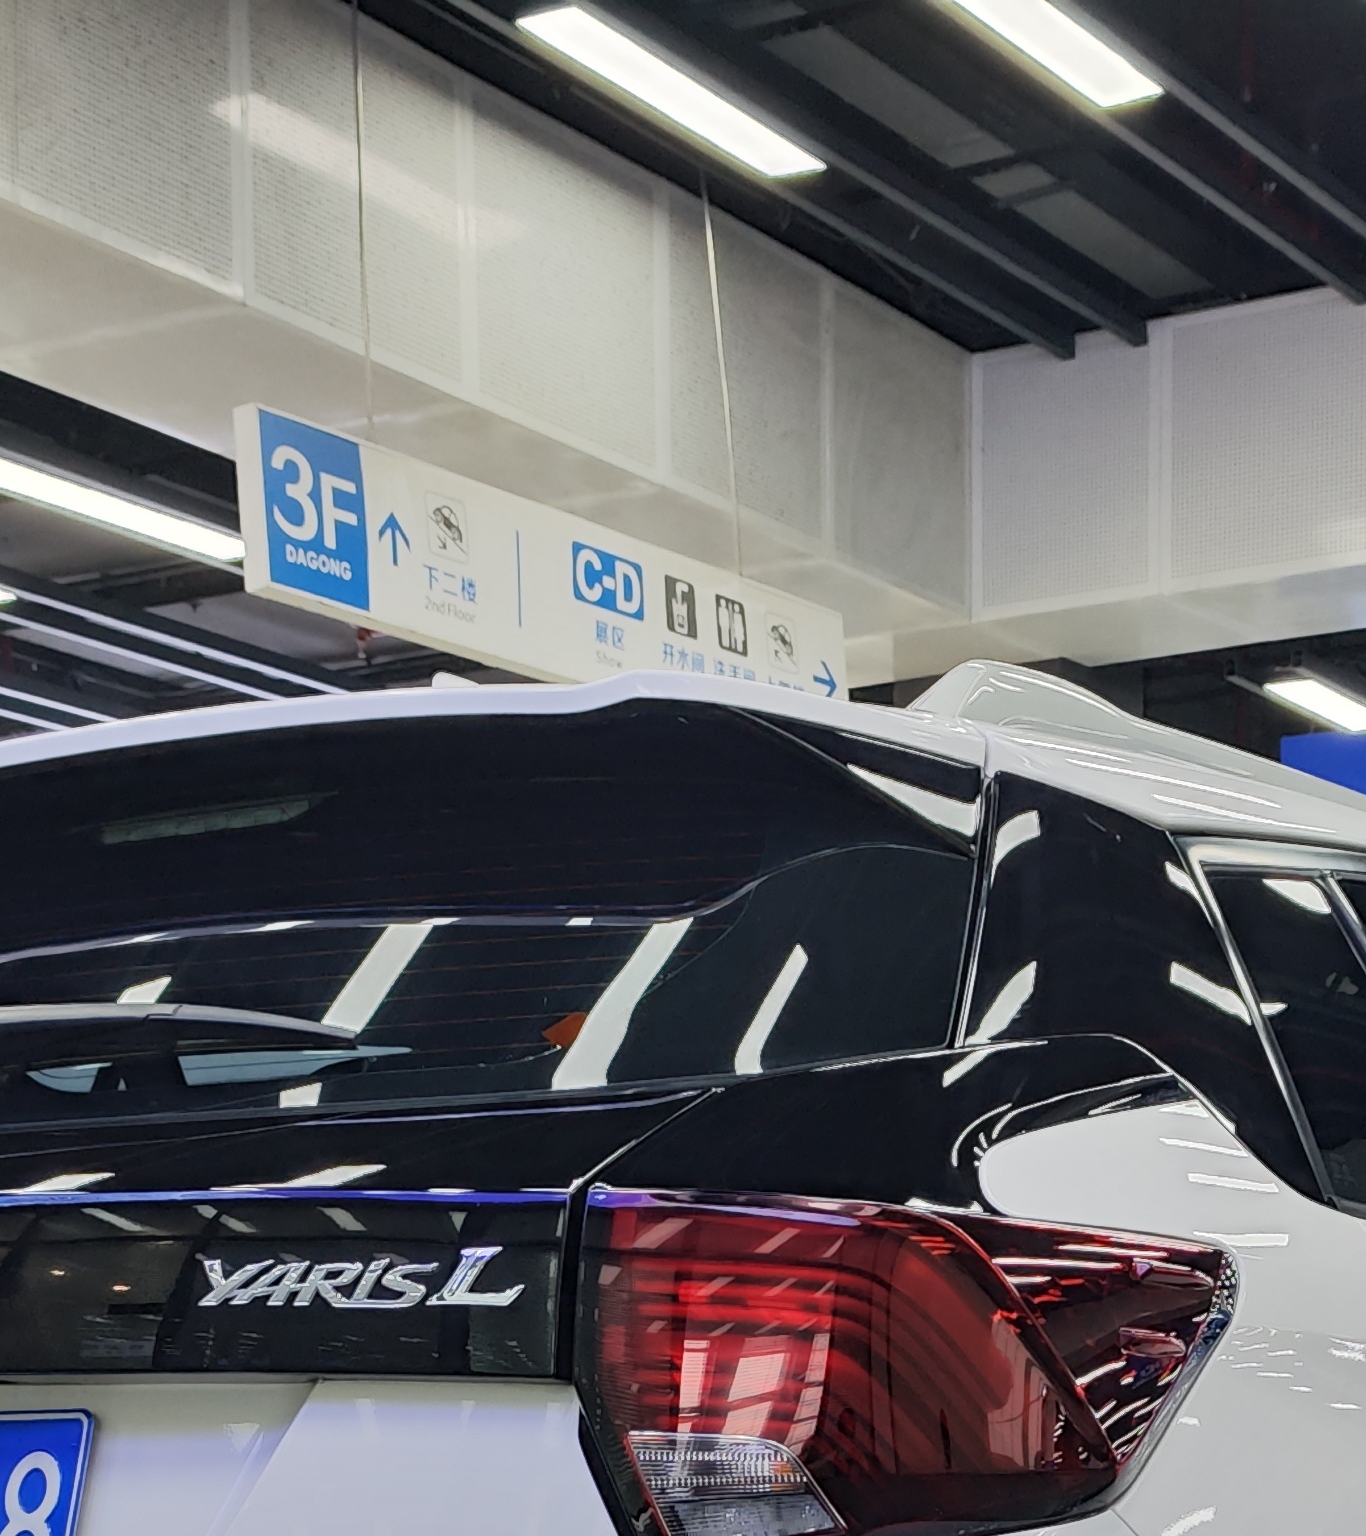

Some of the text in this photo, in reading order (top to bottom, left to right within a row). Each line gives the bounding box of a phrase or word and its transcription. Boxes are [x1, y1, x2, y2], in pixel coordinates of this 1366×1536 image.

[270, 444, 359, 550] 3F
[285, 544, 353, 582] DAGONG
[575, 548, 642, 614] C-D
[423, 564, 478, 605] 下二楼
[596, 619, 626, 652] 展区
[661, 641, 705, 674] 开水间
[197, 1257, 439, 1309] YARIS
